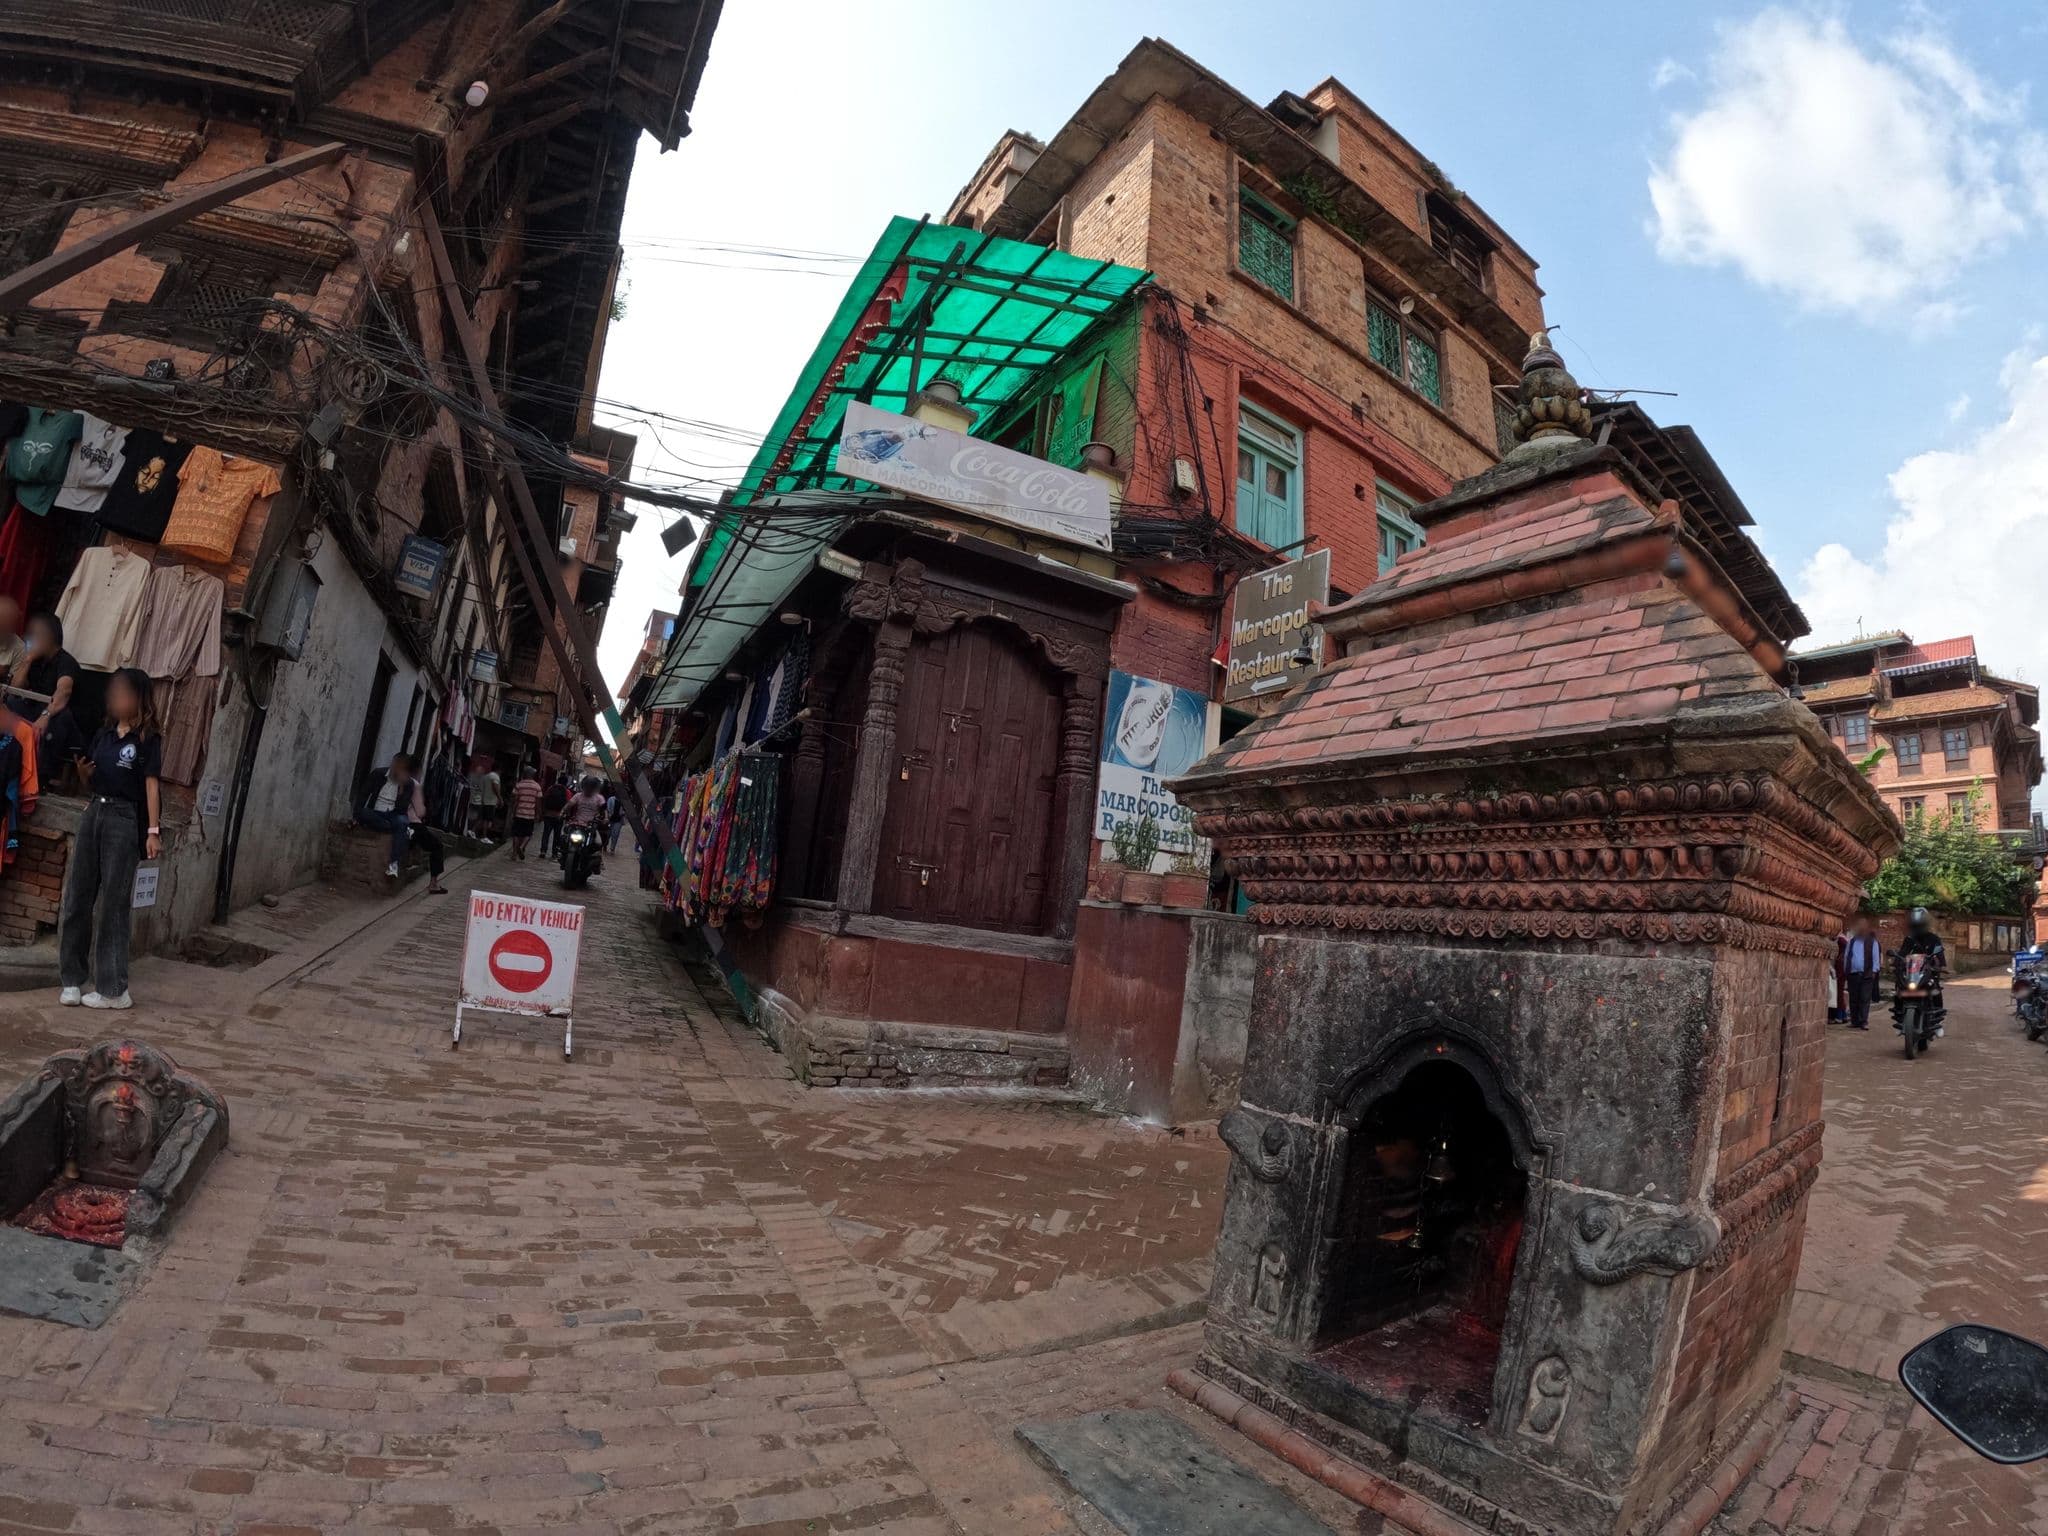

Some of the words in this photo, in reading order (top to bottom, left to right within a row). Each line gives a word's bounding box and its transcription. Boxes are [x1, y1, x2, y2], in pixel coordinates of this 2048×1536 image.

[848, 462, 874, 477] THE
[877, 467, 965, 500] MARCOPOLO
[410, 559, 430, 572] VISA
[1262, 573, 1293, 600] The
[1232, 600, 1308, 647] Marcopol
[1229, 636, 1319, 686] Restaurat
[1120, 700, 1167, 747] TUORG
[1141, 775, 1166, 797] The
[473, 899, 494, 918] NO
[496, 902, 537, 925] ENTRY
[540, 908, 580, 931] VEHICLE
